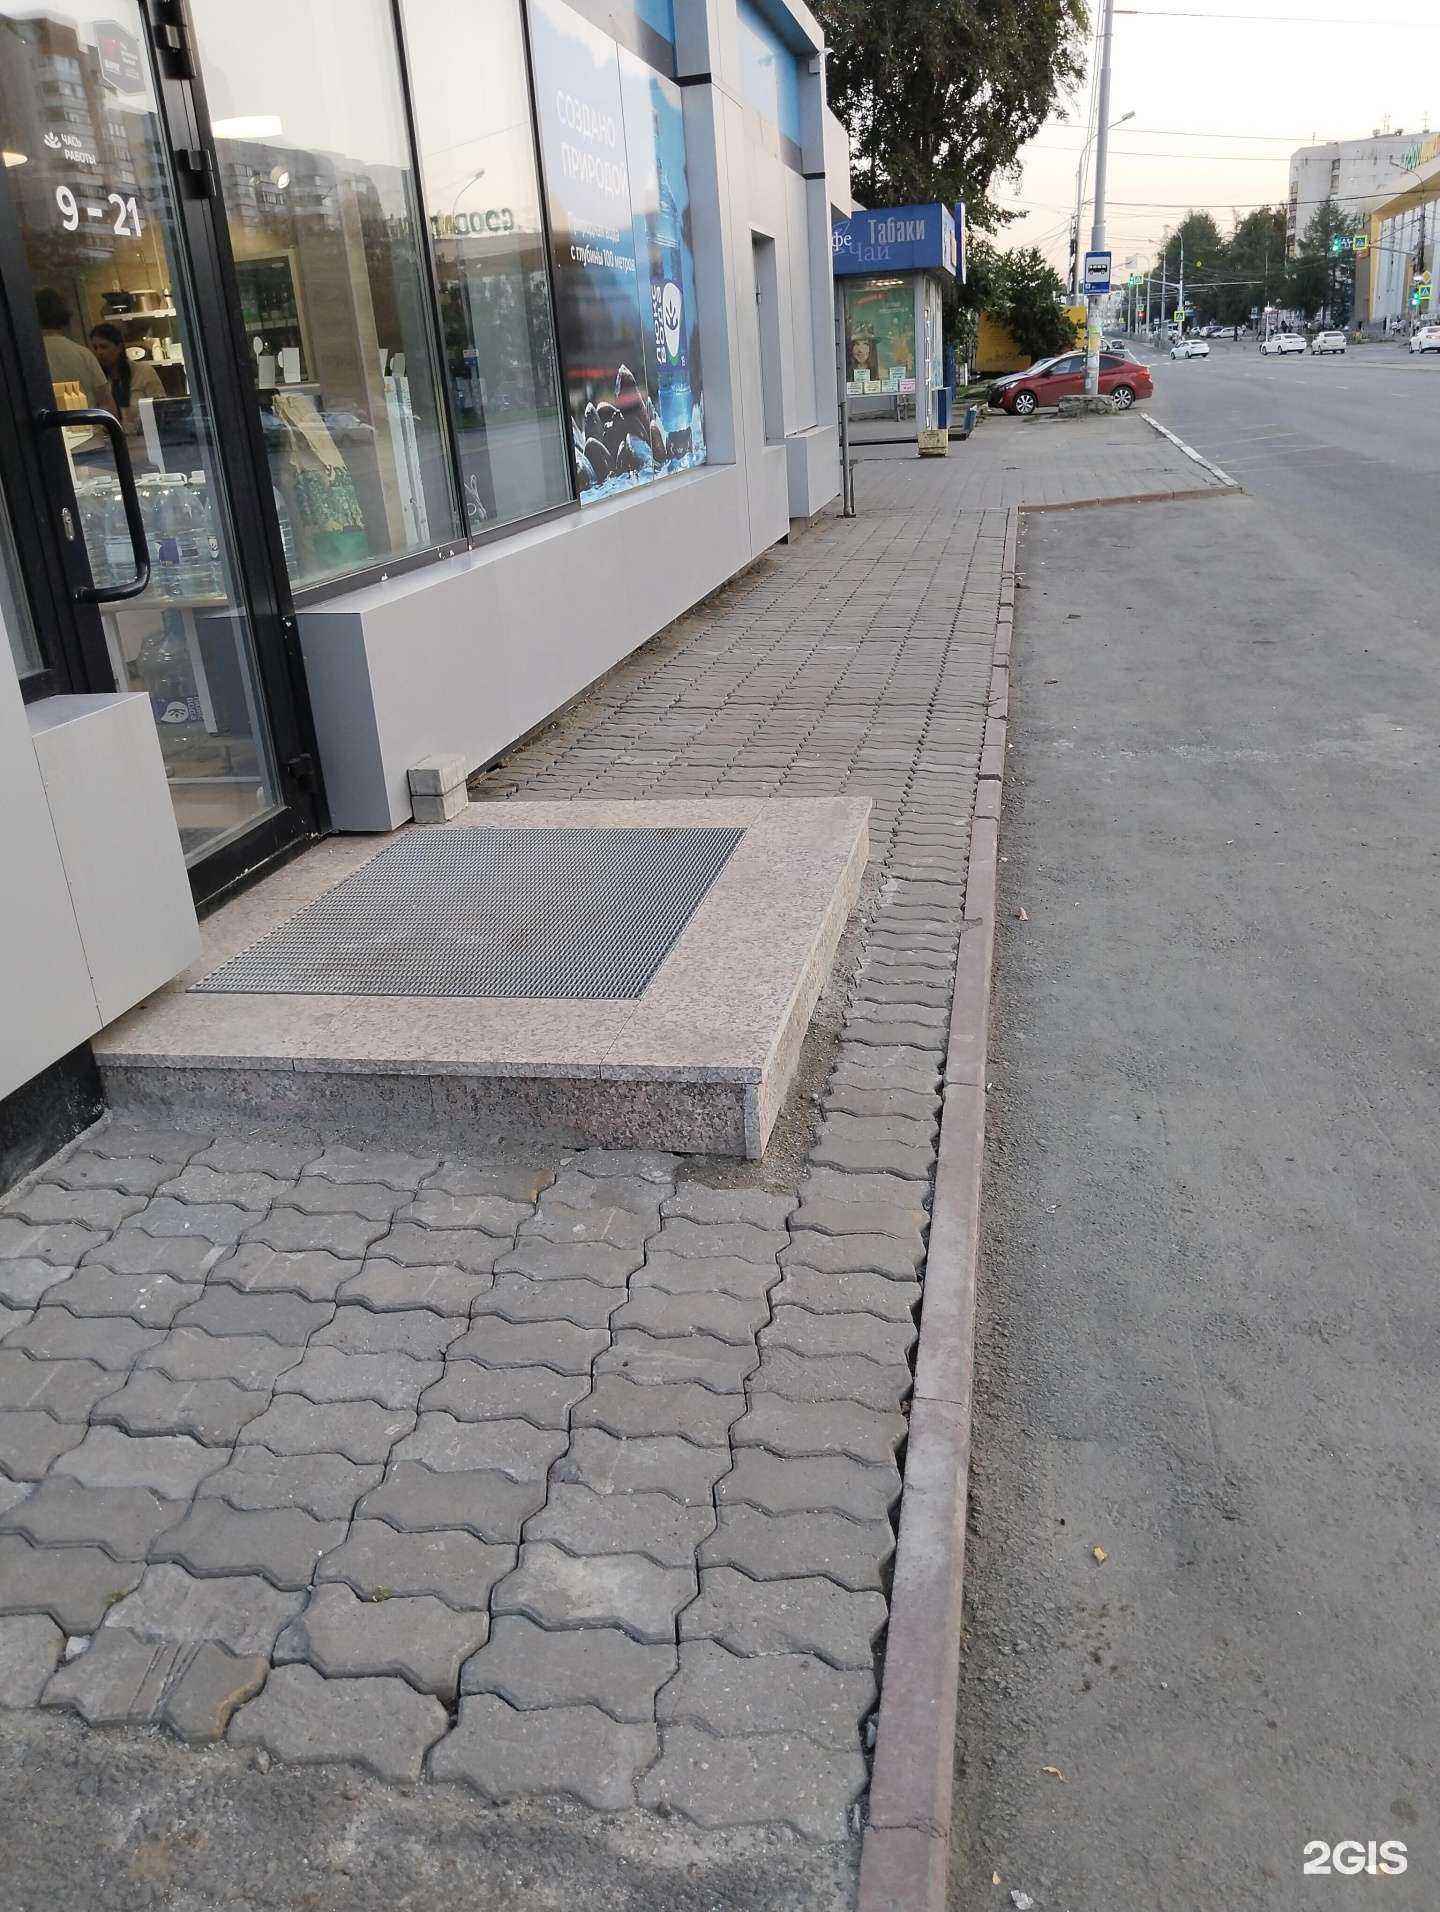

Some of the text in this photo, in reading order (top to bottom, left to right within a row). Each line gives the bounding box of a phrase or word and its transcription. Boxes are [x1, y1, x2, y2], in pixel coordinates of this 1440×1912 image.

[556, 89, 616, 149] СОЗДАНО
[64, 149, 97, 166] РАБОТЫ
[56, 185, 79, 231] 9
[107, 193, 142, 237] 21
[867, 217, 926, 245] Табаки
[575, 244, 604, 267] глубины
[602, 249, 614, 268] 100
[614, 255, 636, 274] метров
